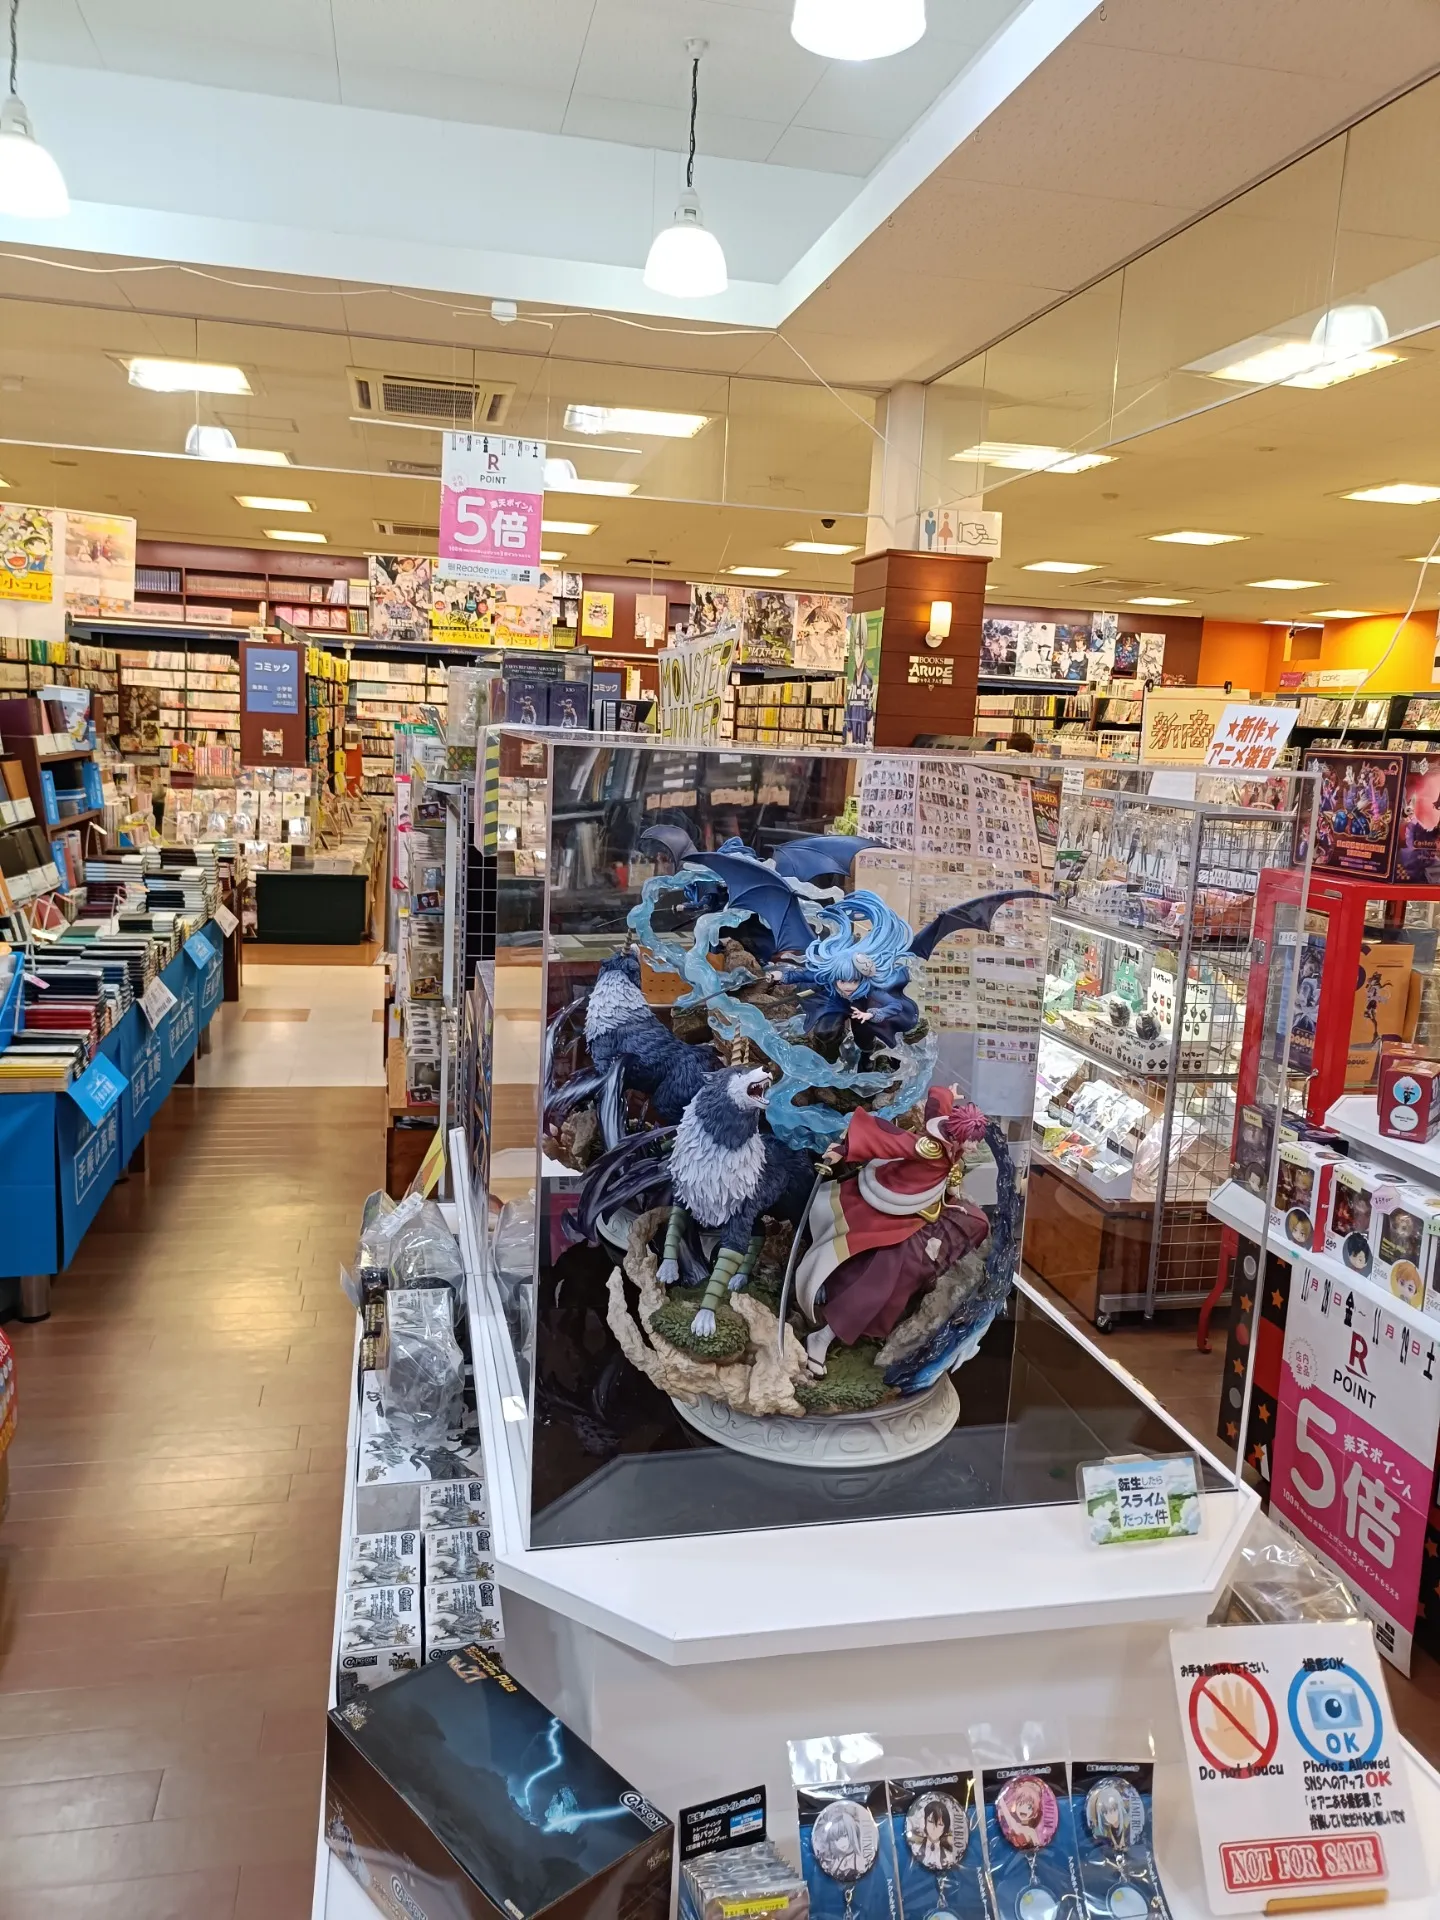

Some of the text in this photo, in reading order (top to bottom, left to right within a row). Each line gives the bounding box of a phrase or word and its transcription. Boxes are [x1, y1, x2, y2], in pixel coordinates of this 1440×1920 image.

[488, 454, 499, 471] R
[480, 475, 506, 484] POINT
[454, 495, 528, 549] 5倍
[456, 563, 489, 574] Readee
[254, 661, 291, 673] コミック
[908, 662, 953, 678] ARUDE
[919, 656, 944, 665] BOOKS
[660, 638, 734, 709] MONSTER
[592, 683, 618, 693] コミック
[661, 696, 721, 747] HUNTER
[1235, 715, 1270, 744] 新作
[1207, 741, 1278, 769] アニメ雑貨
[134, 1052, 162, 1105] 手帳高橋
[1349, 1331, 1369, 1376] R
[1333, 1369, 1377, 1409] POINT
[1343, 1433, 1413, 1501] 楽天ポイント
[1118, 1475, 1164, 1492] 転生したら
[1290, 1397, 1401, 1569] 5倍
[1120, 1492, 1167, 1509] スライム
[1123, 1508, 1169, 1527] だった件
[343, 1655, 377, 1669] CAPCOM
[1302, 1657, 1346, 1673] 撮影OK
[494, 1674, 518, 1693] Plus
[1326, 1732, 1360, 1755] OK
[1199, 1766, 1216, 1781] Do
[1221, 1763, 1242, 1779] not
[1303, 1757, 1391, 1774] Photos Allowed
[623, 1793, 664, 1828] CAPCOM
[1043, 1799, 1056, 1829] MILIM
[692, 1826, 722, 1843] 缶バッジ
[953, 1809, 965, 1848] DIABLO
[1229, 1840, 1378, 1885] NOT FOR SALE
